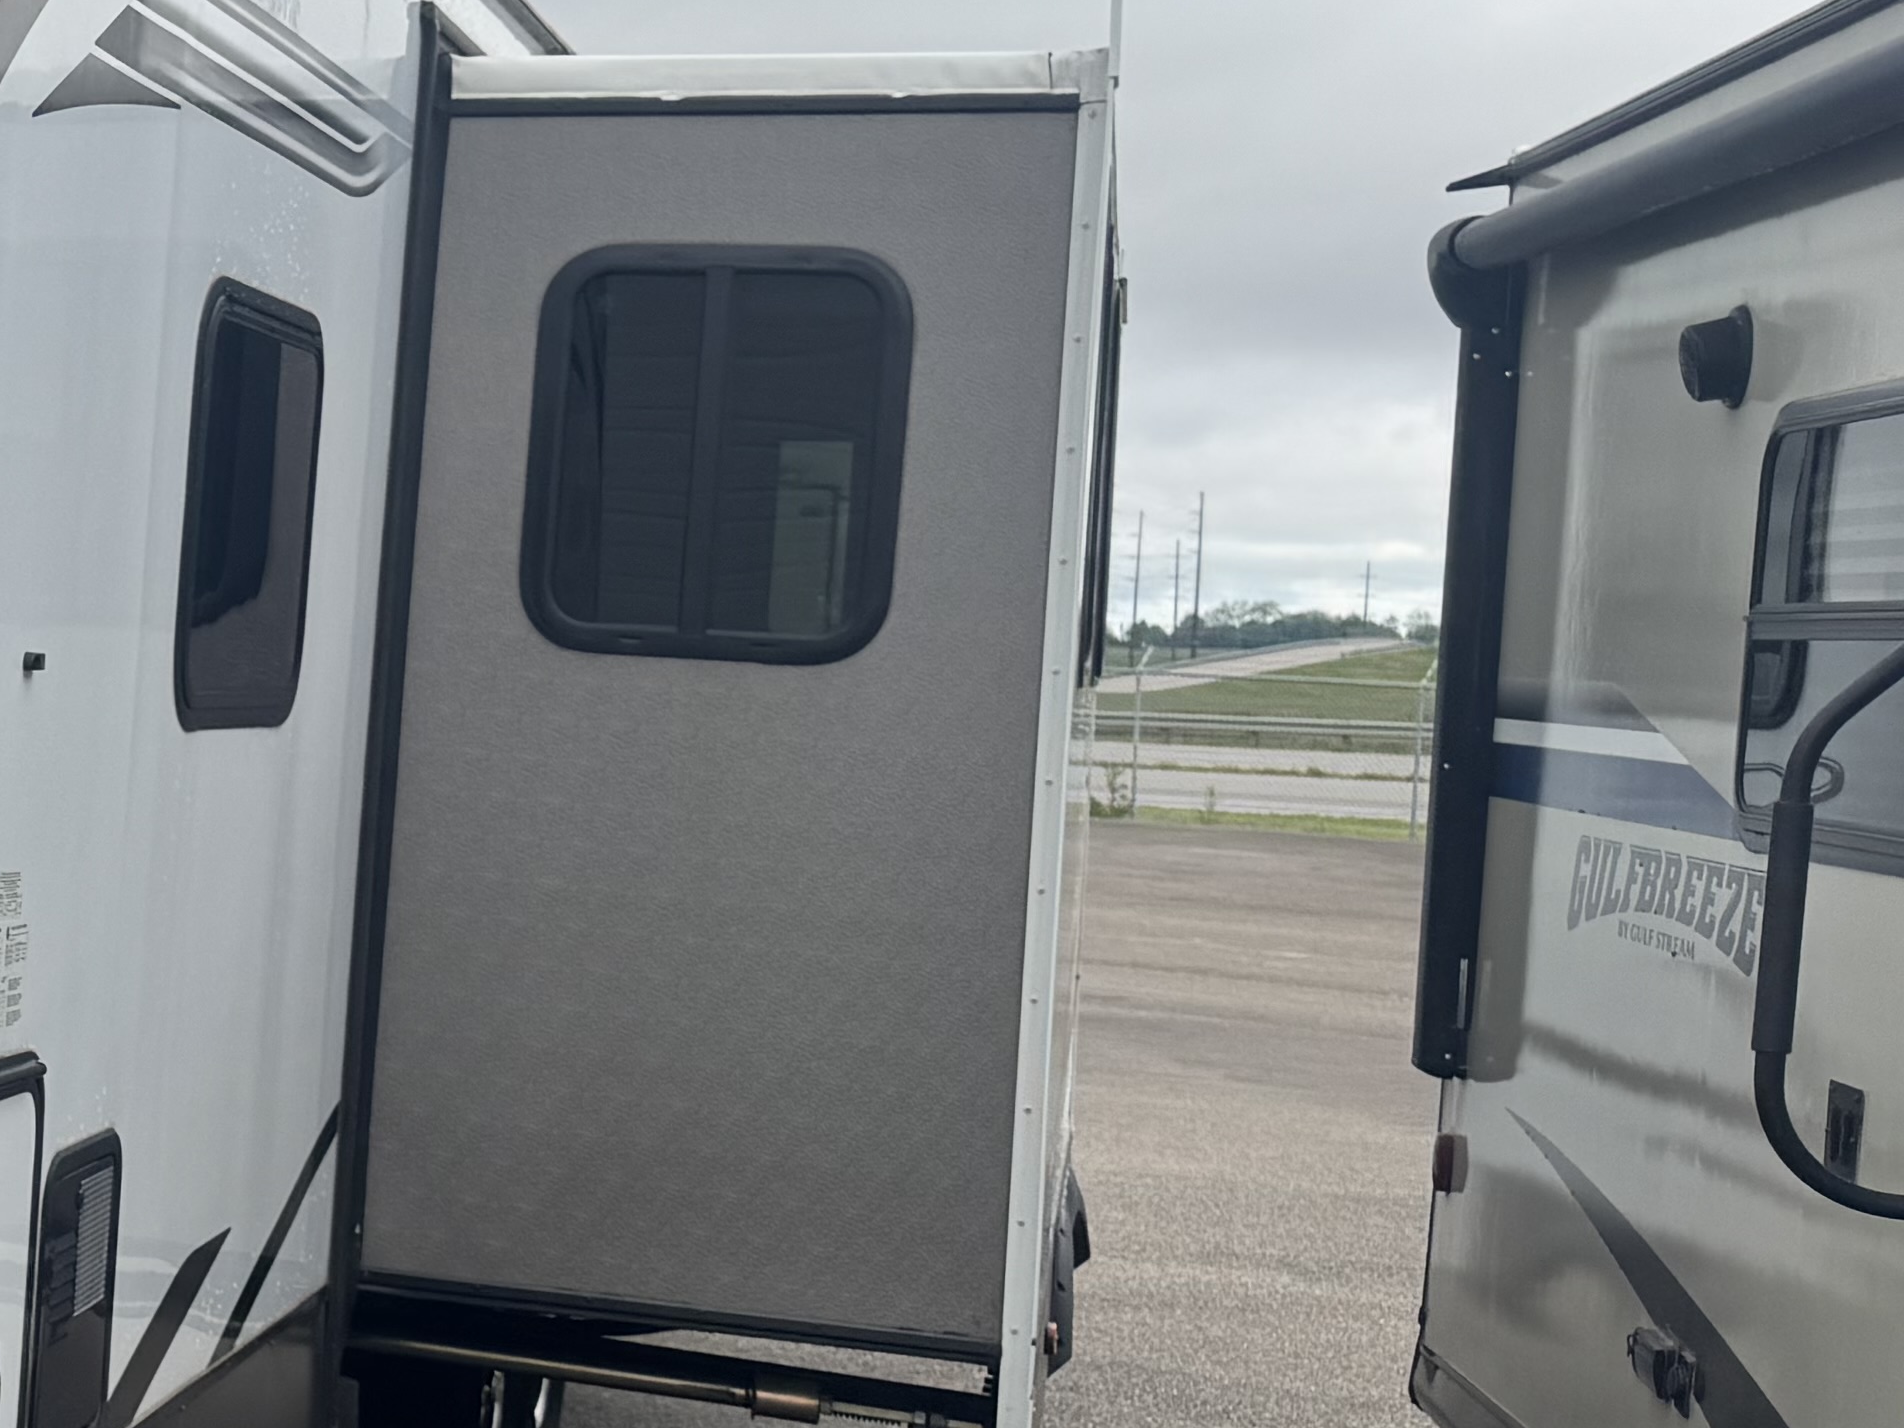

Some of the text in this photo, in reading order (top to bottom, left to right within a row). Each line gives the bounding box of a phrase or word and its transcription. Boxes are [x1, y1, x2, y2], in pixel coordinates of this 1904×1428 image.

[1617, 919, 1696, 960] BY GULF STREAM
